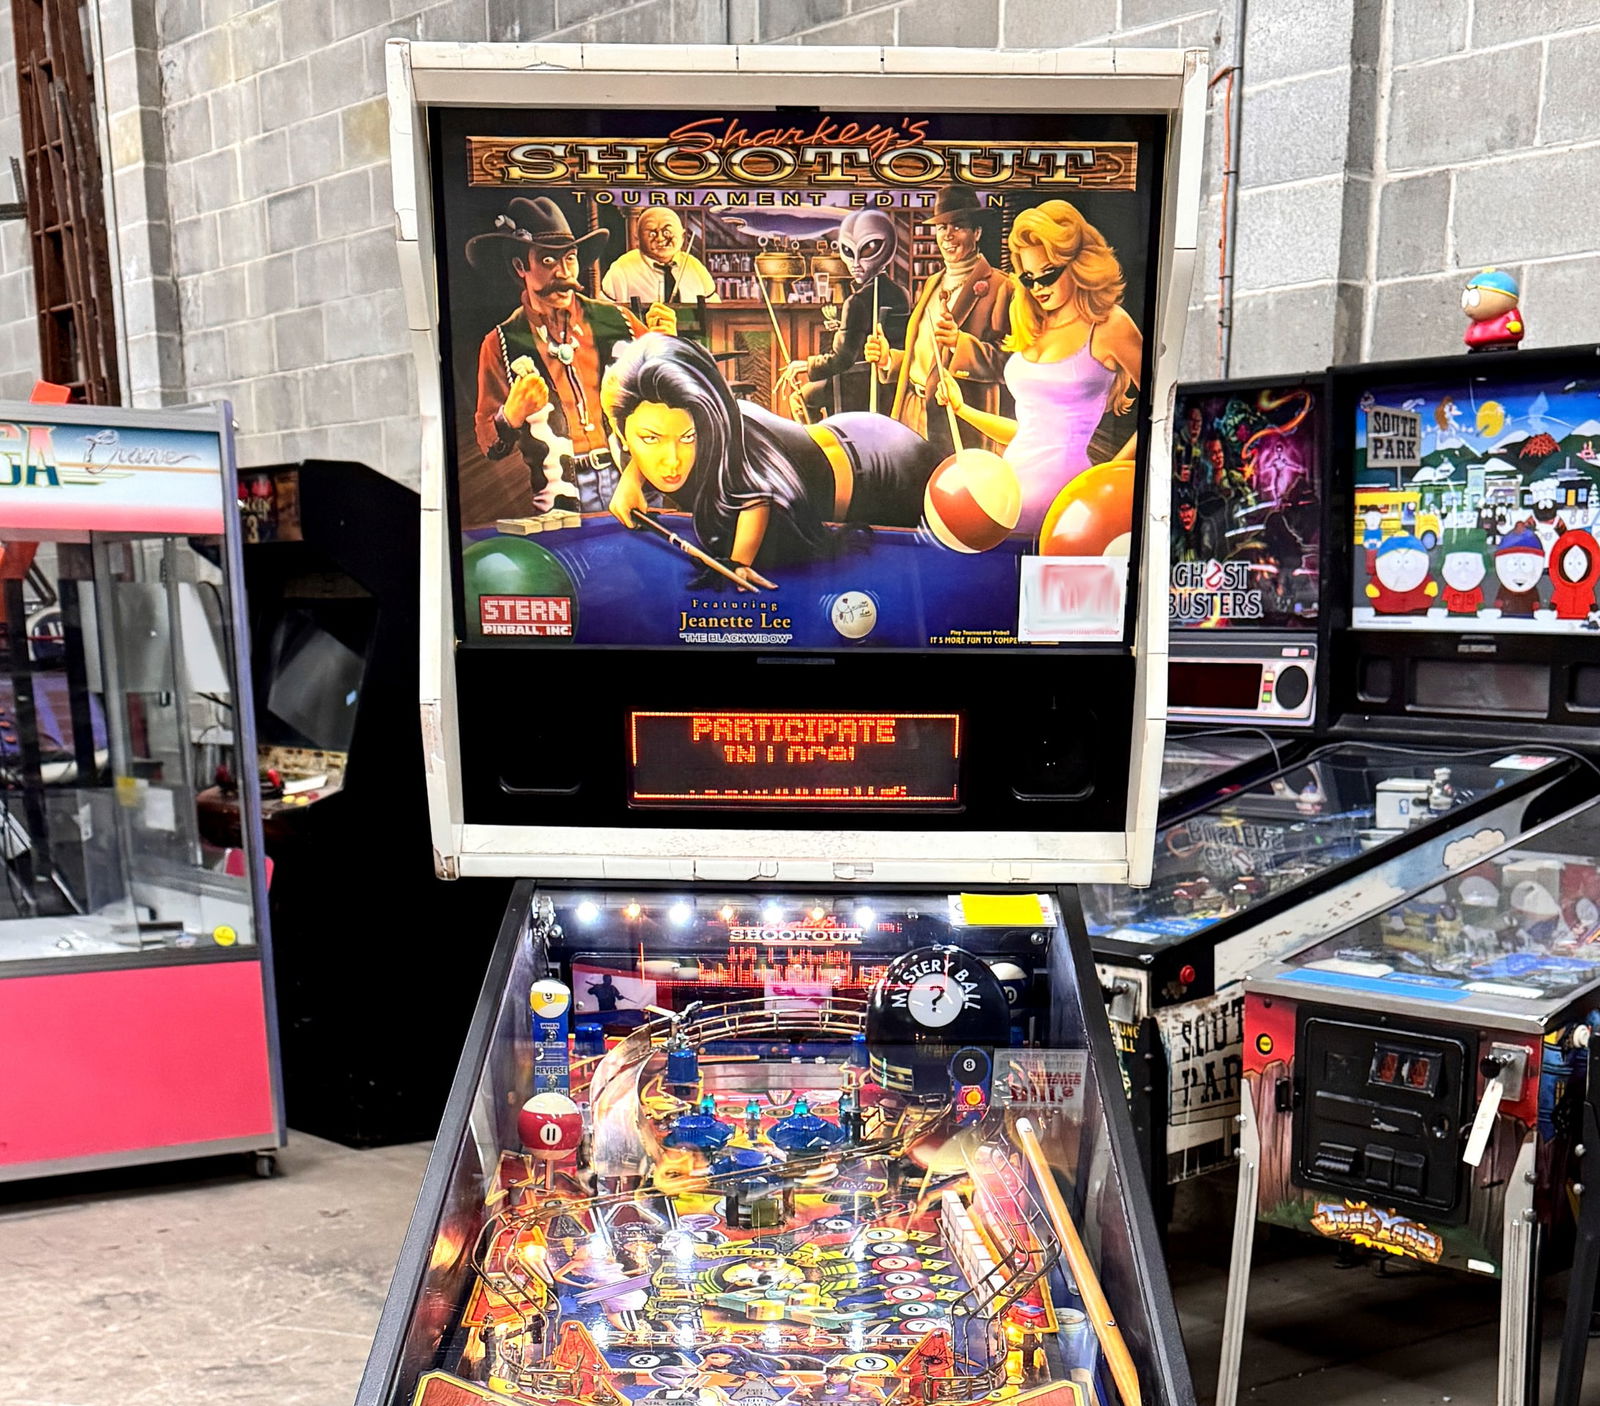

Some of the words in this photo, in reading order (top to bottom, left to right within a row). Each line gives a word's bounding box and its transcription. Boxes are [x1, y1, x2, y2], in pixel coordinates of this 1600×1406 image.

[669, 116, 930, 158] Sharkey's
[505, 142, 1097, 187] SHOOTOUT
[572, 190, 826, 207] TOURNAMENT
[850, 193, 1004, 209] EDITN
[1373, 411, 1418, 437] SOUTH
[80, 429, 201, 475] Crane
[1373, 437, 1417, 460] PARK
[484, 599, 568, 621] STERN
[691, 599, 779, 612] Featuring
[1169, 590, 1263, 619] BUSTERS
[545, 625, 572, 636] INC.
[679, 612, 754, 631] Jeanette
[760, 613, 792, 629] Lee
[708, 633, 745, 644] BLACK
[945, 636, 966, 645] MORE
[983, 636, 993, 645] TO
[692, 717, 896, 742] PARTICIPATE
[729, 929, 862, 941] SHOOTOUT
[890, 958, 955, 1008] MYSTERY
[954, 967, 981, 1010] BALL
[1182, 996, 1244, 1062] SOUT
[536, 1067, 568, 1075] REVERSE
[965, 1060, 973, 1069] 8
[1181, 1055, 1244, 1108] PAR
[546, 1127, 557, 1142] 11
[907, 1305, 919, 1313] 6
[915, 1322, 927, 1330] 7
[637, 1356, 652, 1367] 8
[865, 1358, 879, 1370] 9
